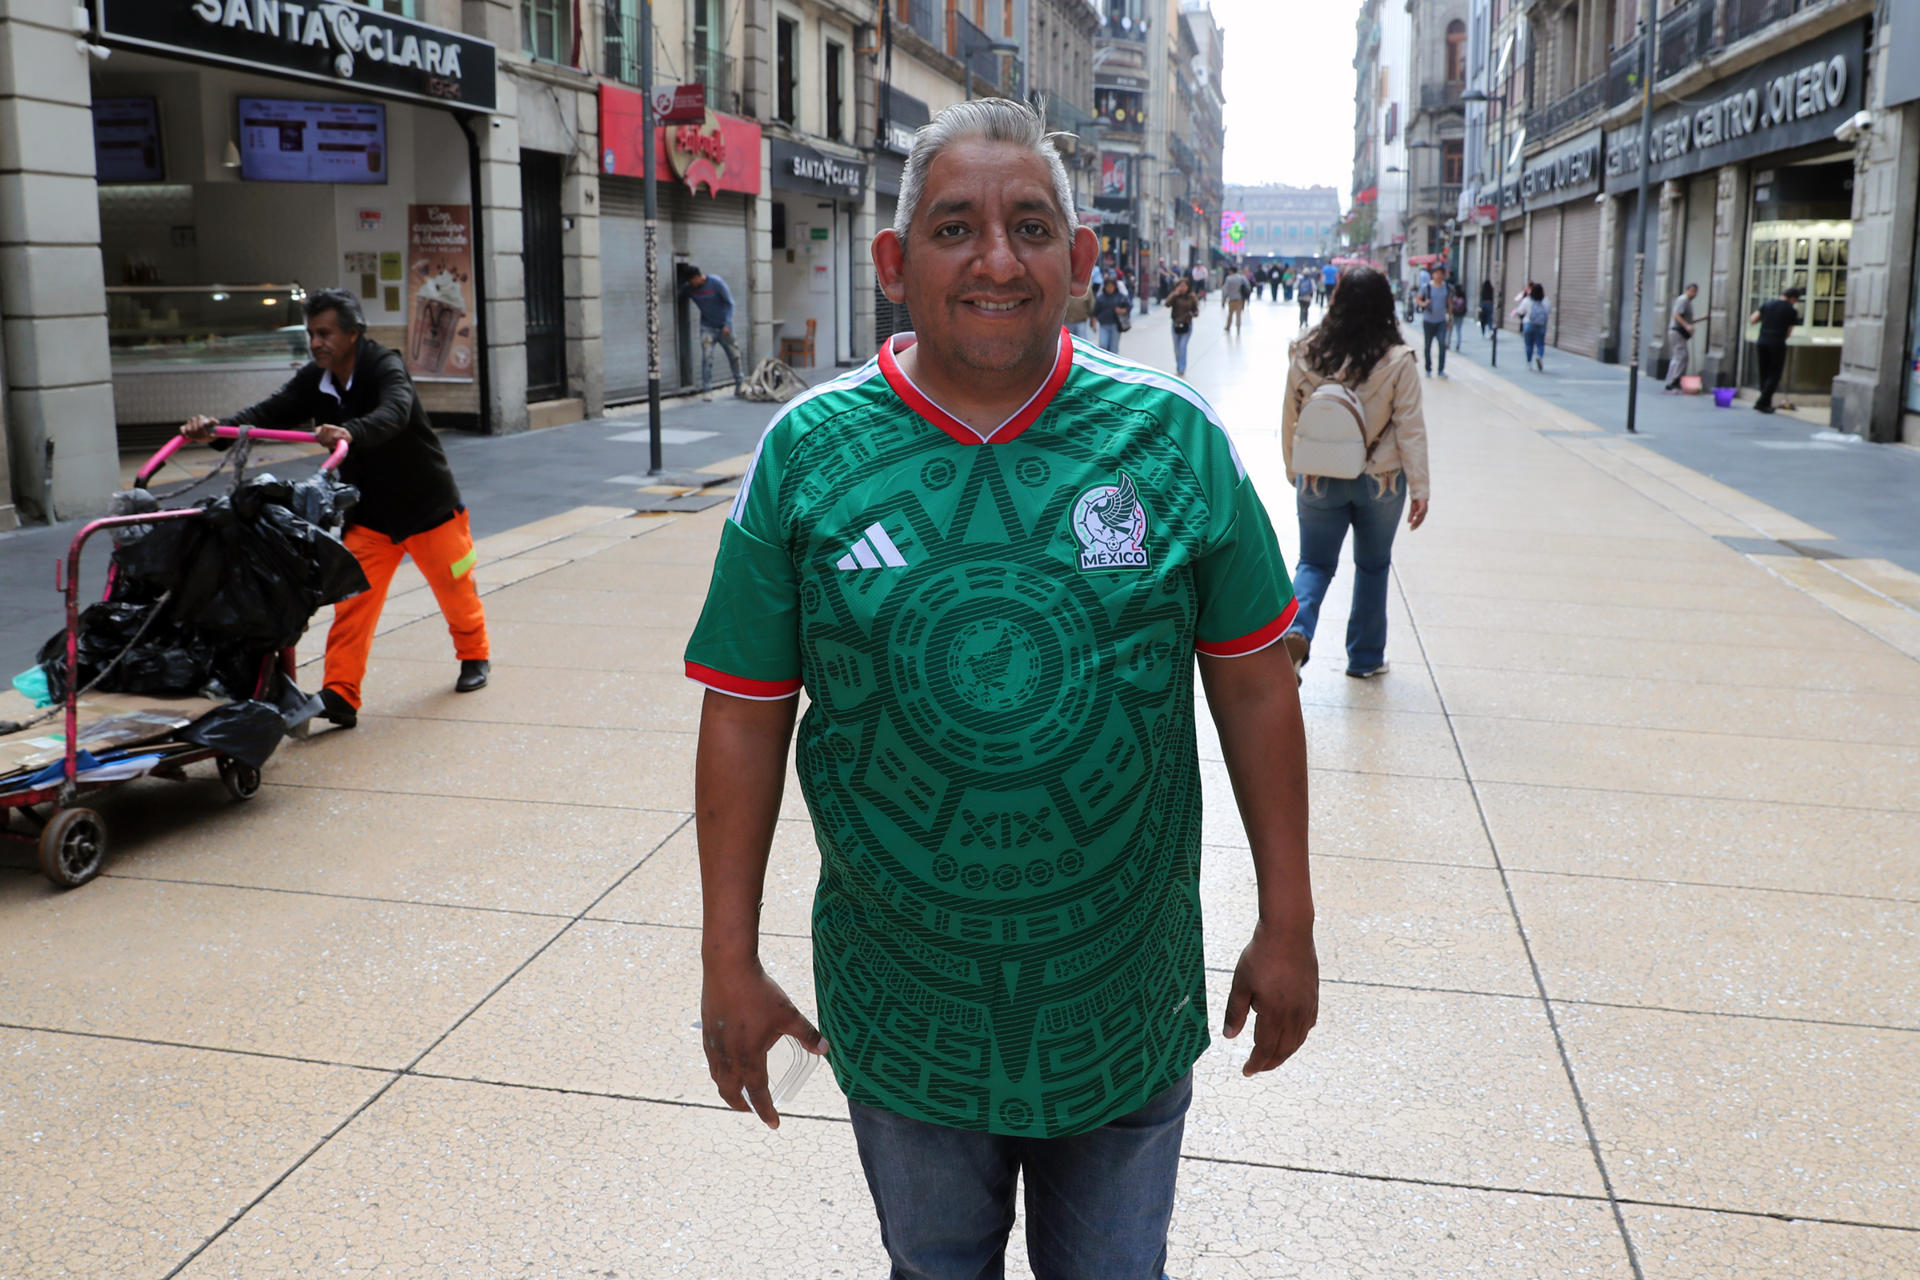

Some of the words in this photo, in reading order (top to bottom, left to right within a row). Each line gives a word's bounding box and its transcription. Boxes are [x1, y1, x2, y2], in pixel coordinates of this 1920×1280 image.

[192, 0, 330, 48] SANTA
[359, 25, 462, 79] CLARA
[1693, 88, 1758, 149] CENTRO
[1760, 54, 1847, 129] JOYERO
[793, 156, 826, 181] SANTA
[831, 165, 859, 185] CLARA
[1083, 550, 1145, 567] MÉXICO
